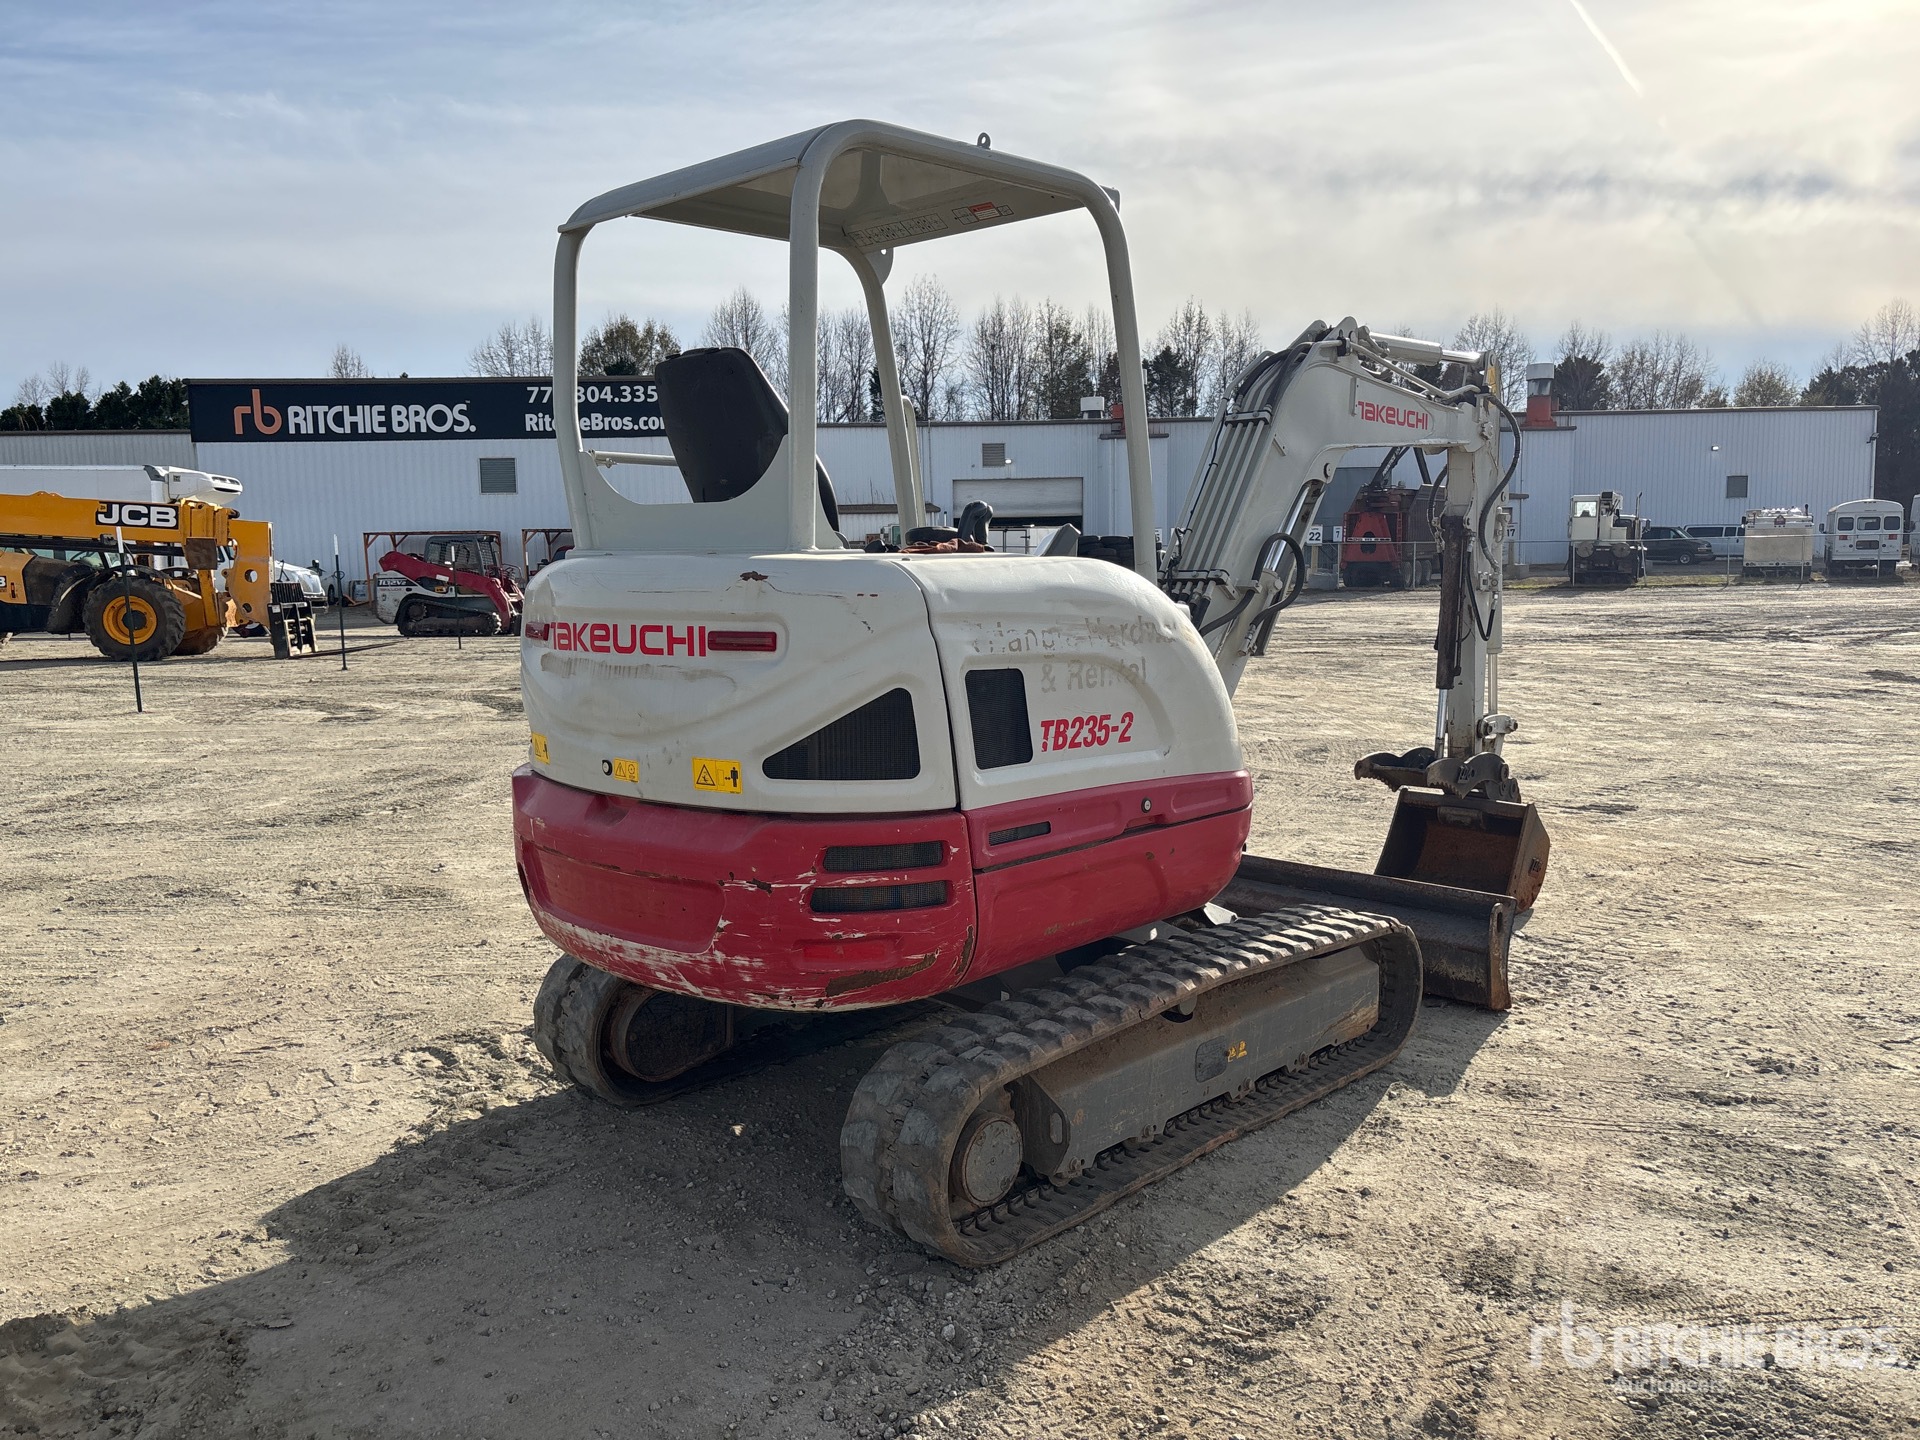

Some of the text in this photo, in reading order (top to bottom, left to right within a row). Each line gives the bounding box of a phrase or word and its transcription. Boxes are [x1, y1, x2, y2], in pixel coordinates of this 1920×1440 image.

[287, 404, 387, 435] RITCHIE
[391, 403, 477, 434] BROS.
[97, 503, 178, 528] JCB
[1308, 531, 1321, 541] 22
[1335, 530, 1340, 538] 7
[1040, 711, 1135, 753] TB235-2
